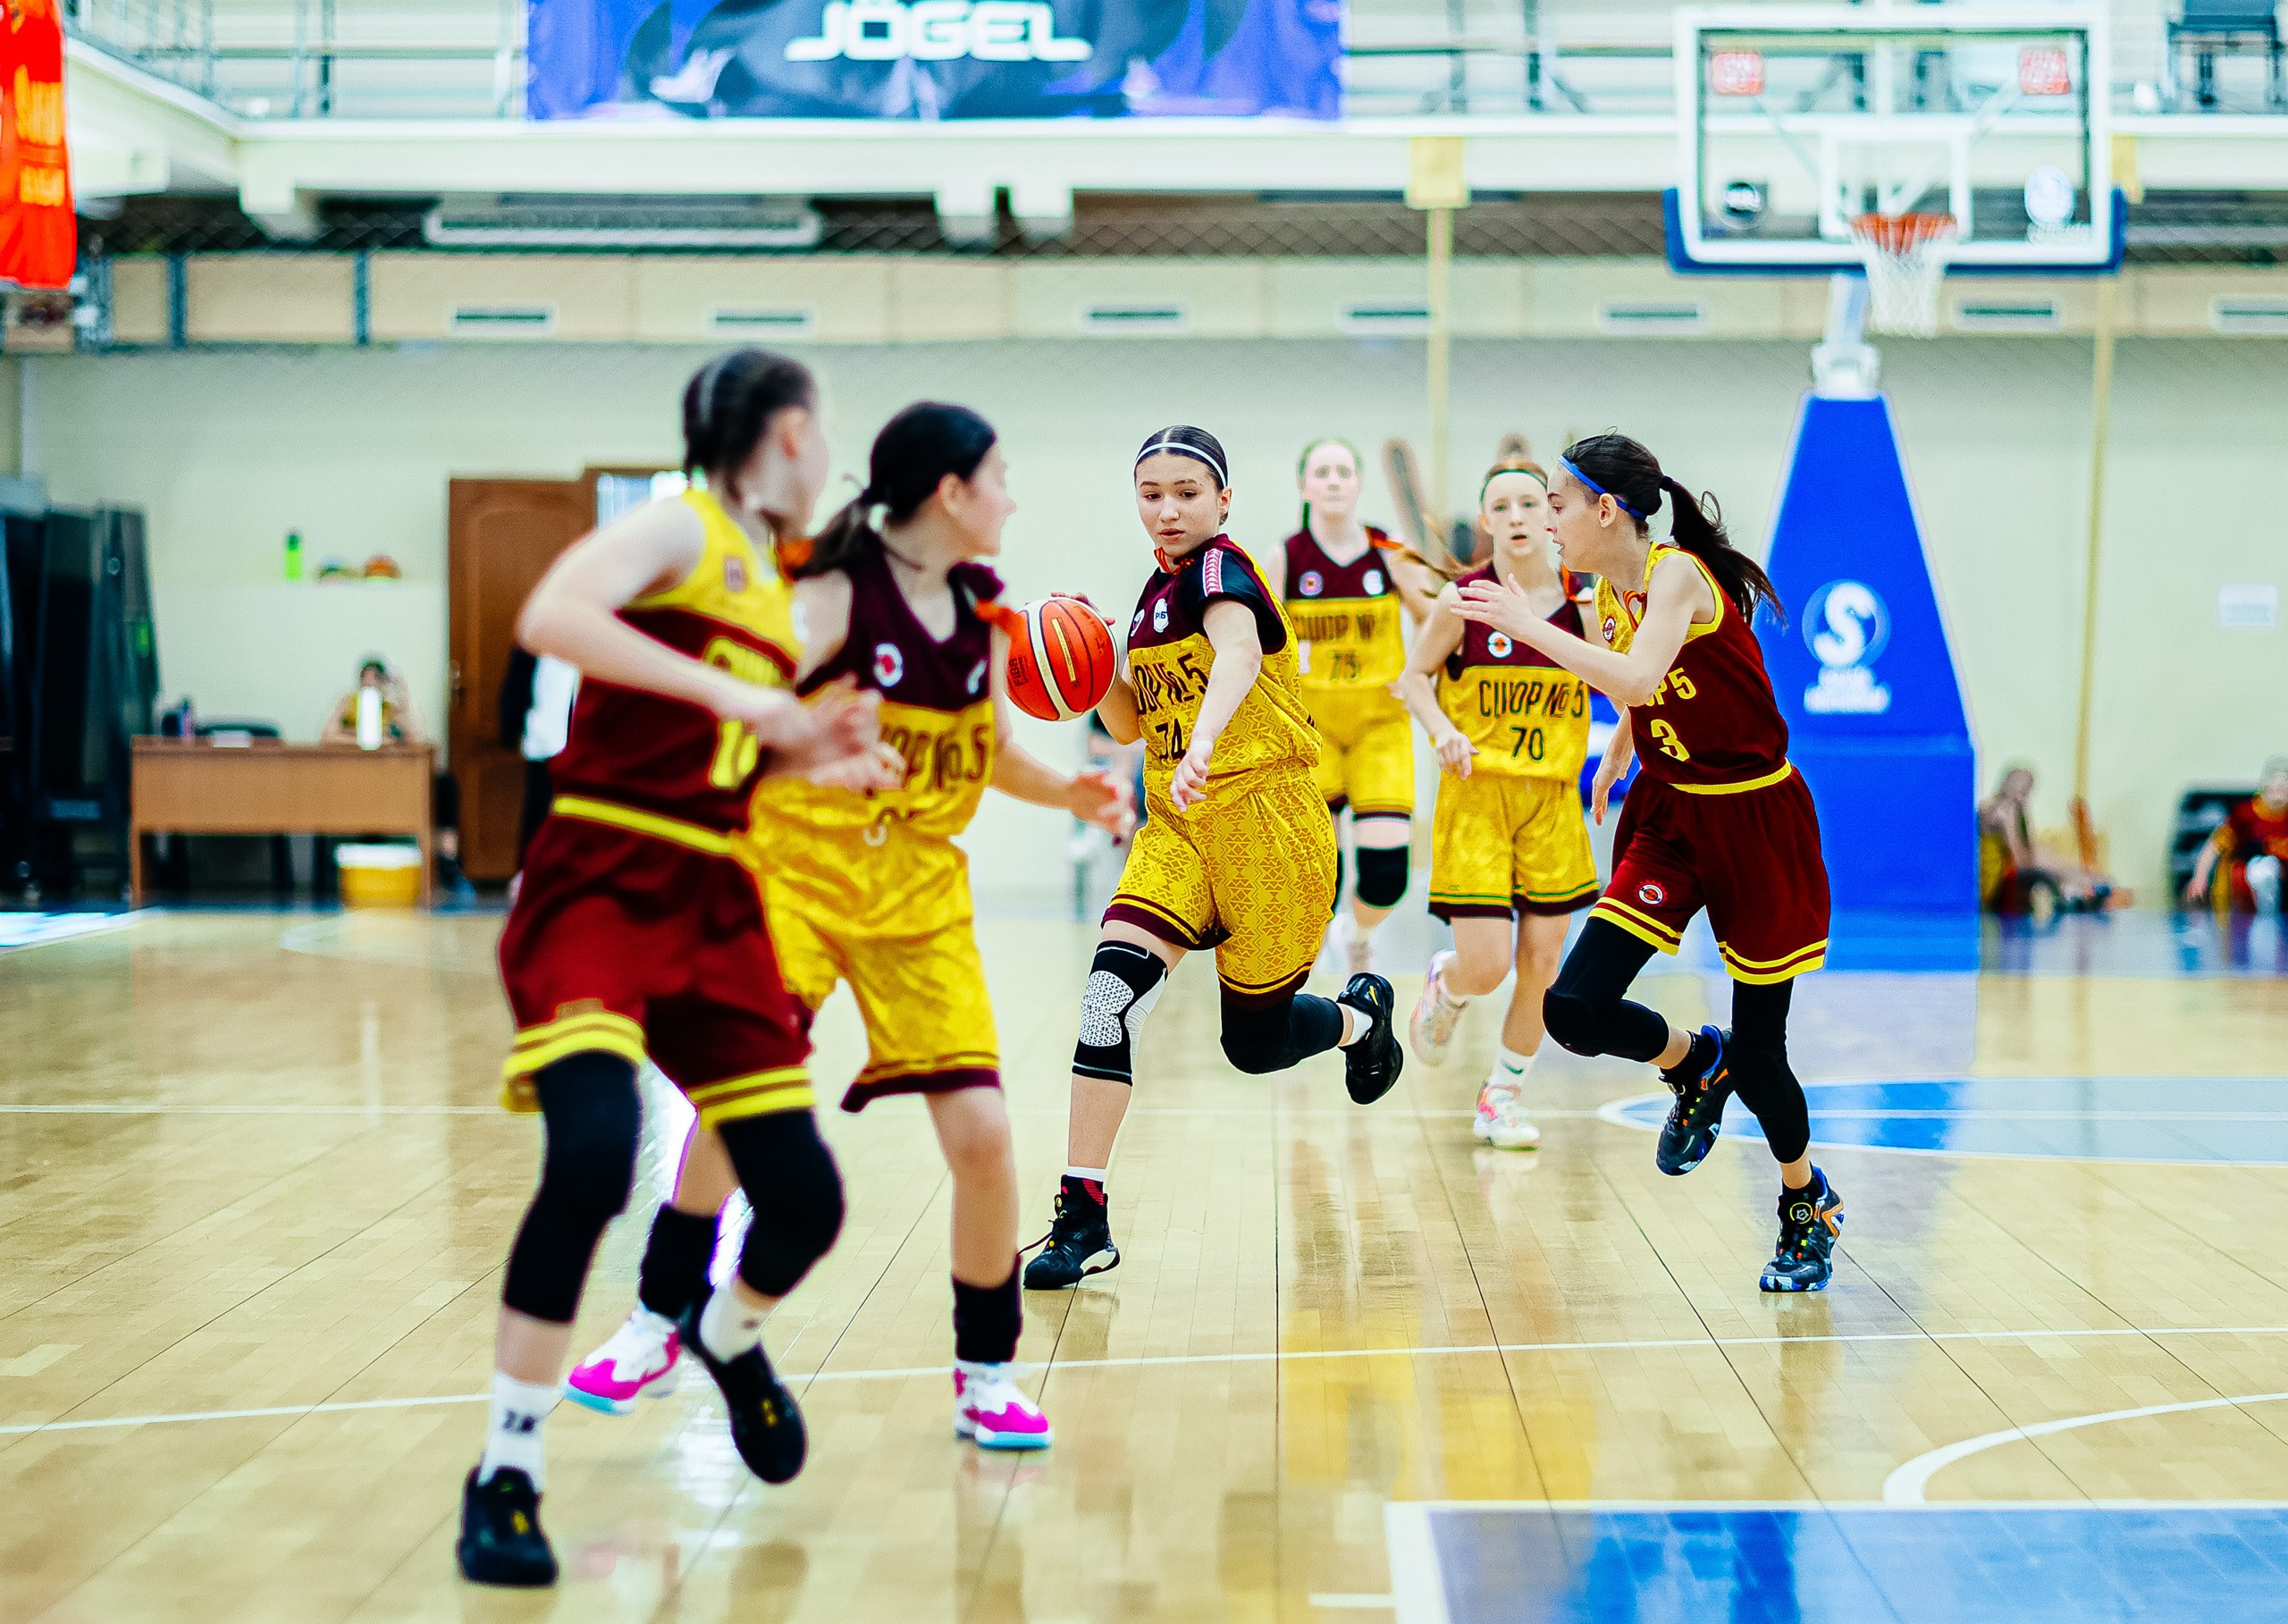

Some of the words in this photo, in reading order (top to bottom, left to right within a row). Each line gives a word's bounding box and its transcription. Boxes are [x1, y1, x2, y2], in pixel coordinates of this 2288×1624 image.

[1176, 652, 1209, 695] 5
[1510, 726, 1544, 762] 70
[1650, 719, 1690, 762] 3
